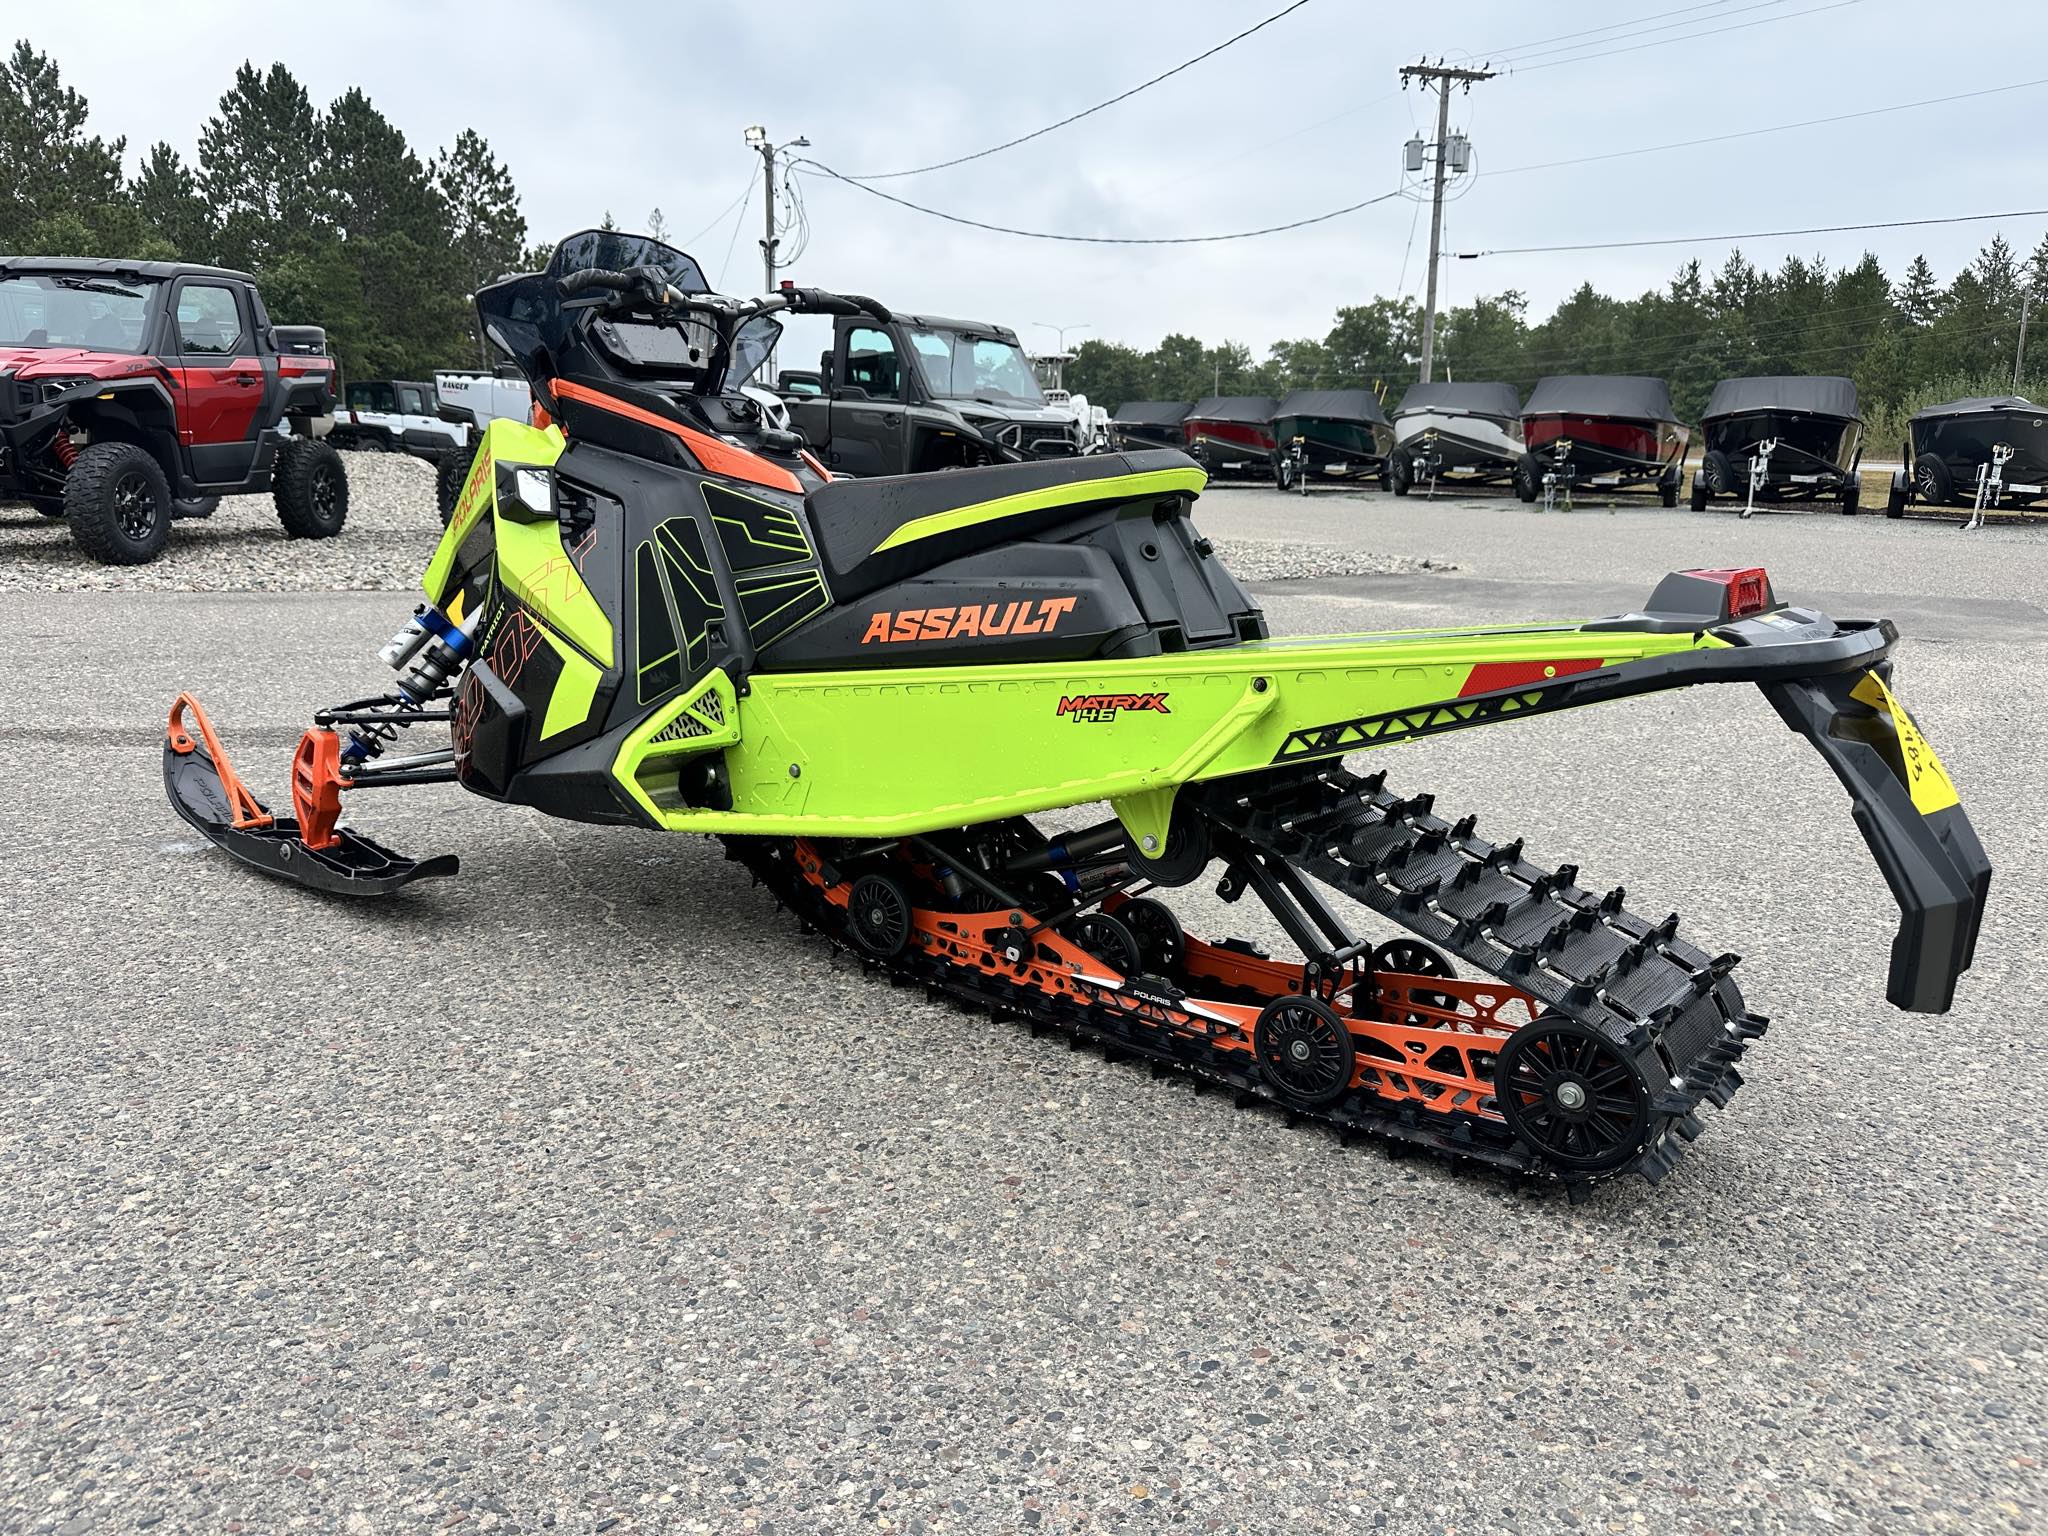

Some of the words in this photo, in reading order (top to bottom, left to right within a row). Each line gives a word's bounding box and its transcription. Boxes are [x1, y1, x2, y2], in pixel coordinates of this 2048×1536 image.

[127, 364, 144, 372] XP
[442, 381, 470, 391] RANGER
[480, 601, 506, 657] PATRIOT
[861, 597, 1077, 644] ASSAULT
[1056, 693, 1171, 715] MATRYX
[1073, 708, 1117, 723] 146
[1133, 990, 1171, 1007] POLARIS
